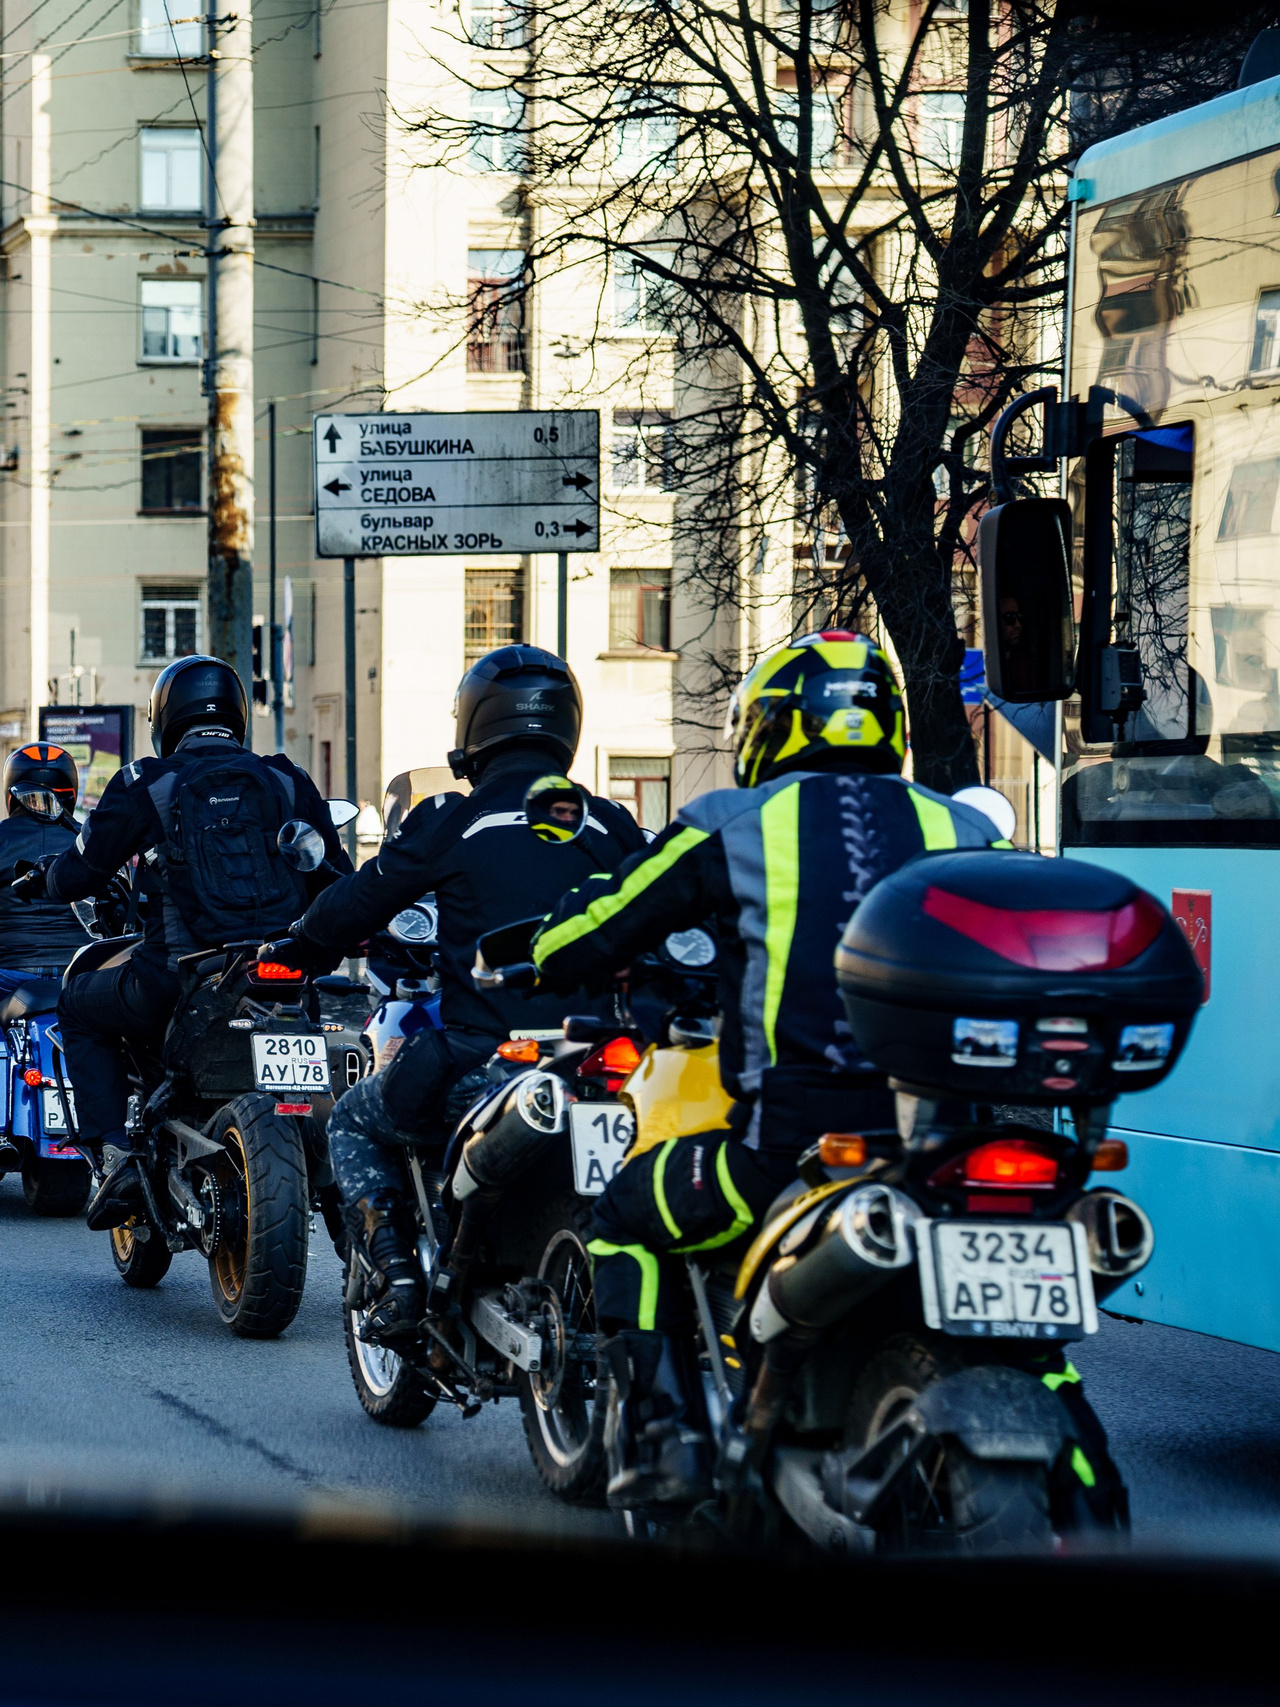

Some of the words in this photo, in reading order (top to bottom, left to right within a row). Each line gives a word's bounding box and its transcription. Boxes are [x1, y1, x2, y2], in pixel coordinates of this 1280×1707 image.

[360, 422, 412, 438] улица
[534, 427, 559, 444] 0,5
[361, 439, 475, 456] БАБУШКИНА
[360, 469, 412, 485] улица
[361, 487, 436, 505] СЕДОВА
[361, 513, 433, 532] бульвар
[534, 521, 560, 537] 0,3
[361, 534, 448, 551] КРАСНЫХ
[454, 533, 503, 549] ЗОРЬ
[515, 703, 556, 712] SHARK
[265, 1038, 316, 1056] 2810
[261, 1064, 288, 1081] АУ
[299, 1065, 324, 1082] 78
[591, 1112, 631, 1144] 16
[959, 1231, 1054, 1264] 3234
[954, 1282, 1003, 1315] АР
[1023, 1284, 1069, 1318] 78
[990, 1323, 1037, 1337] BMW
